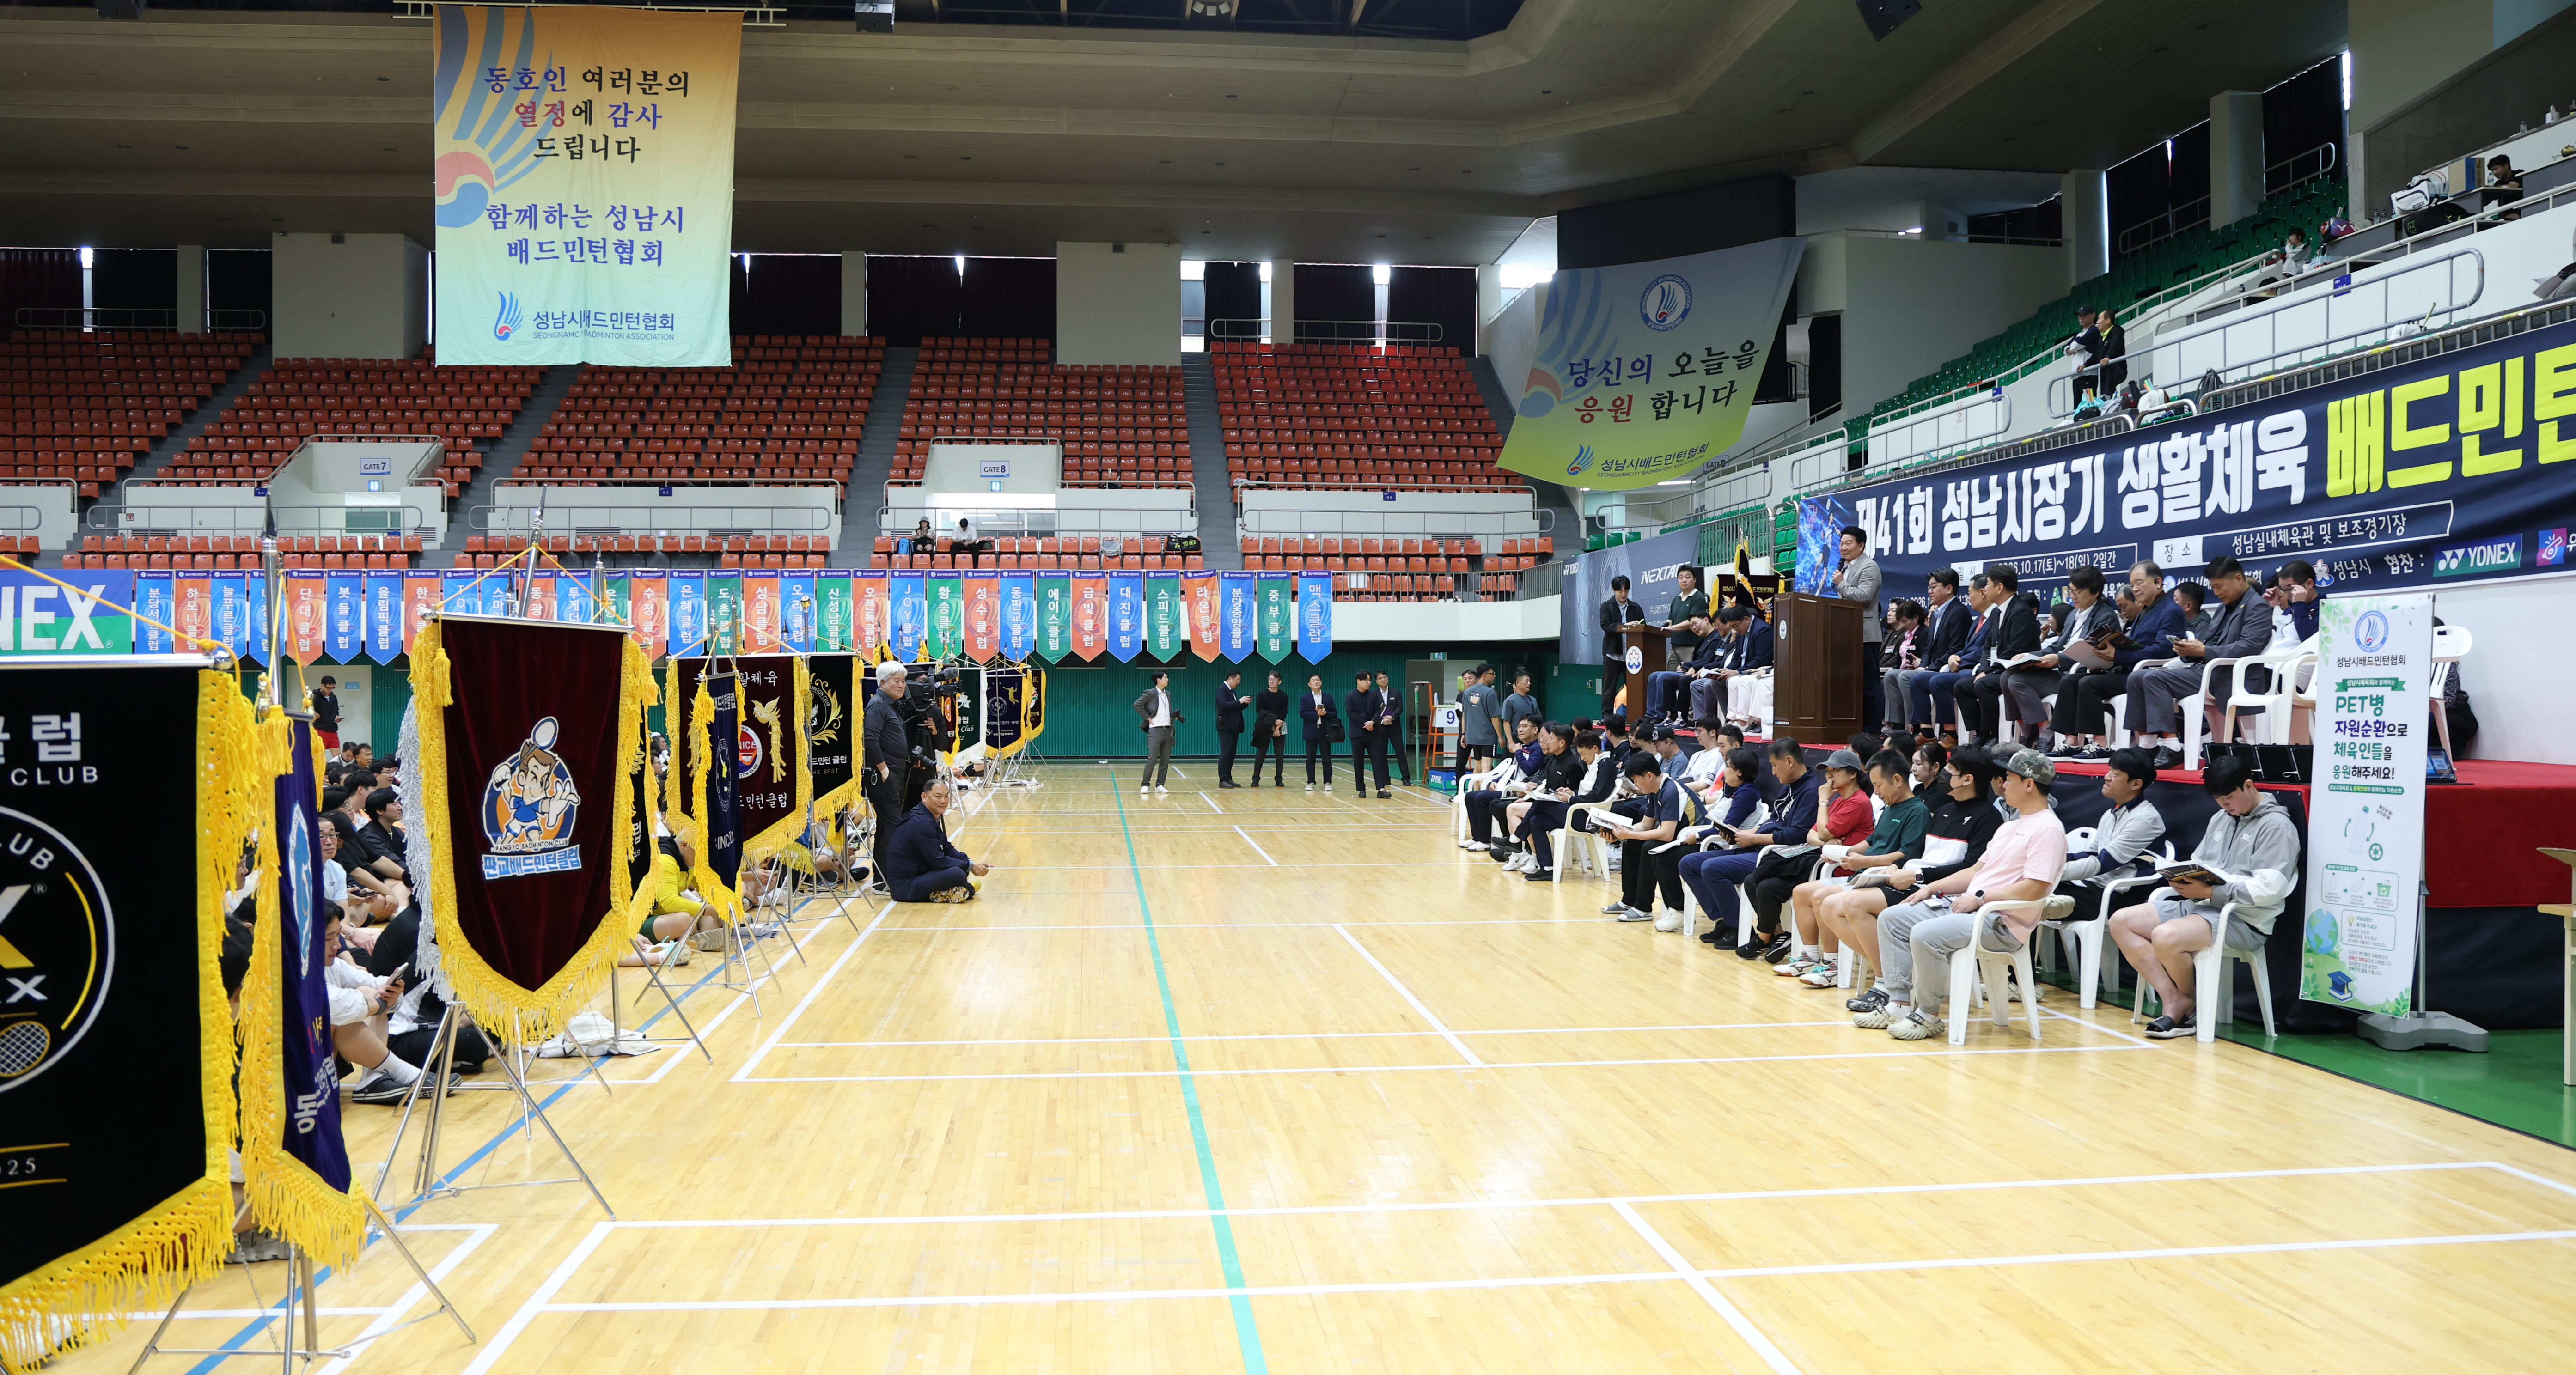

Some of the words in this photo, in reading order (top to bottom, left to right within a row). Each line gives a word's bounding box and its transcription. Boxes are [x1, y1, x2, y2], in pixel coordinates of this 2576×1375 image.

[484, 66, 567, 93] 동호인
[582, 66, 689, 97] 여러분의
[515, 99, 593, 128] 열정에
[608, 102, 663, 130] 감사
[533, 134, 641, 163] 드립니다
[486, 203, 592, 231] 함께하는
[605, 204, 684, 233] 성남시
[507, 237, 663, 267] 배드민턴협회
[533, 309, 674, 331] 성남시배드민턴협회
[1569, 354, 1653, 388] 당신의
[1668, 339, 1760, 379] 오늘을
[1574, 394, 1634, 424] 응원
[1650, 380, 1738, 421] 합니다
[1601, 442, 1709, 472] 성남시배드민턴협회
[1856, 485, 1933, 559] 제41회
[1942, 453, 2106, 552] 성남시장기
[2118, 409, 2309, 529] 생활체육
[2232, 523, 2314, 556] 성남실내체육관
[2319, 523, 2332, 545] 및
[2338, 513, 2407, 540] 보조경기장
[2093, 551, 2116, 569] 2일간
[2333, 558, 2372, 581] 성남시
[2384, 553, 2414, 575] 협찬
[2467, 542, 2516, 568] YONEX
[299, 588, 312, 651] 단대클럽
[338, 587, 350, 648] 봇들클럽
[377, 586, 390, 650] 올림픽클럽
[680, 584, 693, 644] 은혜클럽
[755, 586, 768, 645] 성남클럽
[828, 588, 840, 650] 신성남클럽
[902, 584, 912, 647] JOY클럽
[938, 586, 951, 644] 황송클럽
[976, 587, 988, 649] 성수클럽
[1010, 587, 1022, 648] 동판교클럽
[1047, 588, 1060, 651] 에이스클럽
[1082, 586, 1094, 647] 금빛클럽
[1119, 586, 1131, 648] 대진클럽
[1157, 589, 1170, 650] 스피드클럽
[1196, 585, 1213, 644] 라온클럽
[1231, 587, 1243, 649] 분당중앙클럽
[1268, 590, 1280, 651] 중부클럽
[1308, 584, 1321, 643] 맥스클럽
[739, 671, 778, 687] 활체육
[2337, 655, 2406, 667] 성남시배드민턴협회
[1447, 711, 1455, 724] 9
[2336, 694, 2384, 717] PET병
[2335, 720, 2408, 737] 자원순환으로
[832, 755, 847, 764] 클럽
[2334, 742, 2393, 760] 체육인들을
[11, 766, 98, 786] CLUB
[2332, 765, 2395, 779] 응원해주세요!
[484, 846, 580, 877] 판교배드민턴클럽
[521, 841, 553, 850] BADMINTON
